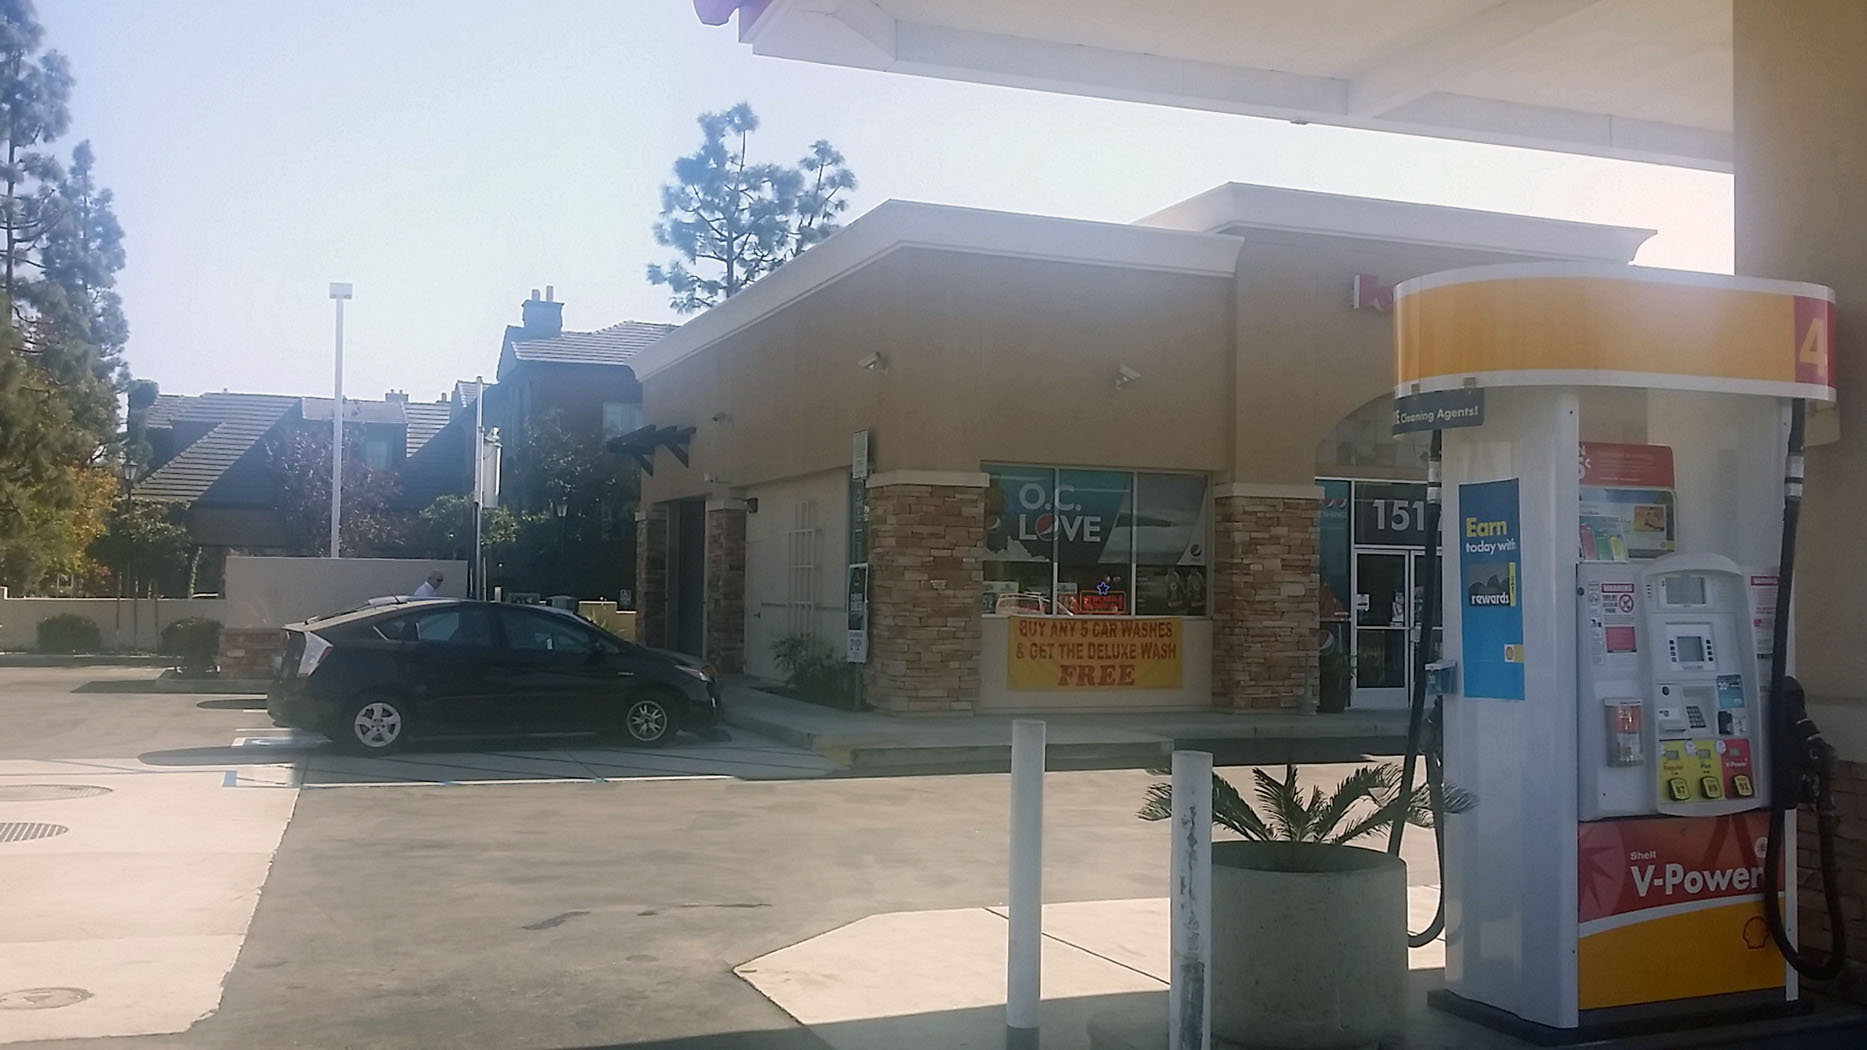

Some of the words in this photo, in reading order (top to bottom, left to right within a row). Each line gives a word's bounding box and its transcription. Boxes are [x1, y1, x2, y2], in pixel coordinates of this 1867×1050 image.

[1354, 273, 1393, 312] Fo
[1799, 317, 1827, 377] 4
[1401, 410, 1434, 424] Cleaning
[1436, 405, 1479, 421] Agents!
[1018, 482, 1083, 512] O.C.
[1373, 499, 1443, 532] 151
[1018, 513, 1102, 543] LOVE
[1466, 517, 1507, 538] Earn
[1466, 540, 1496, 555] today
[1498, 538, 1517, 551] with
[1471, 592, 1510, 605] rewards
[1019, 620, 1046, 637] BUY
[1050, 620, 1075, 637] ANY
[1080, 620, 1089, 637] 5
[1092, 621, 1117, 637] CAR
[1120, 621, 1173, 638] WASHES
[1016, 642, 1026, 660] &
[1029, 642, 1054, 660] GET
[1059, 642, 1084, 660] THE
[1088, 642, 1137, 660] DELUXE
[1140, 642, 1177, 660] WASH
[1057, 664, 1136, 687] FREE
[1630, 851, 1657, 861] Shell
[1630, 863, 1764, 898] V-Power
